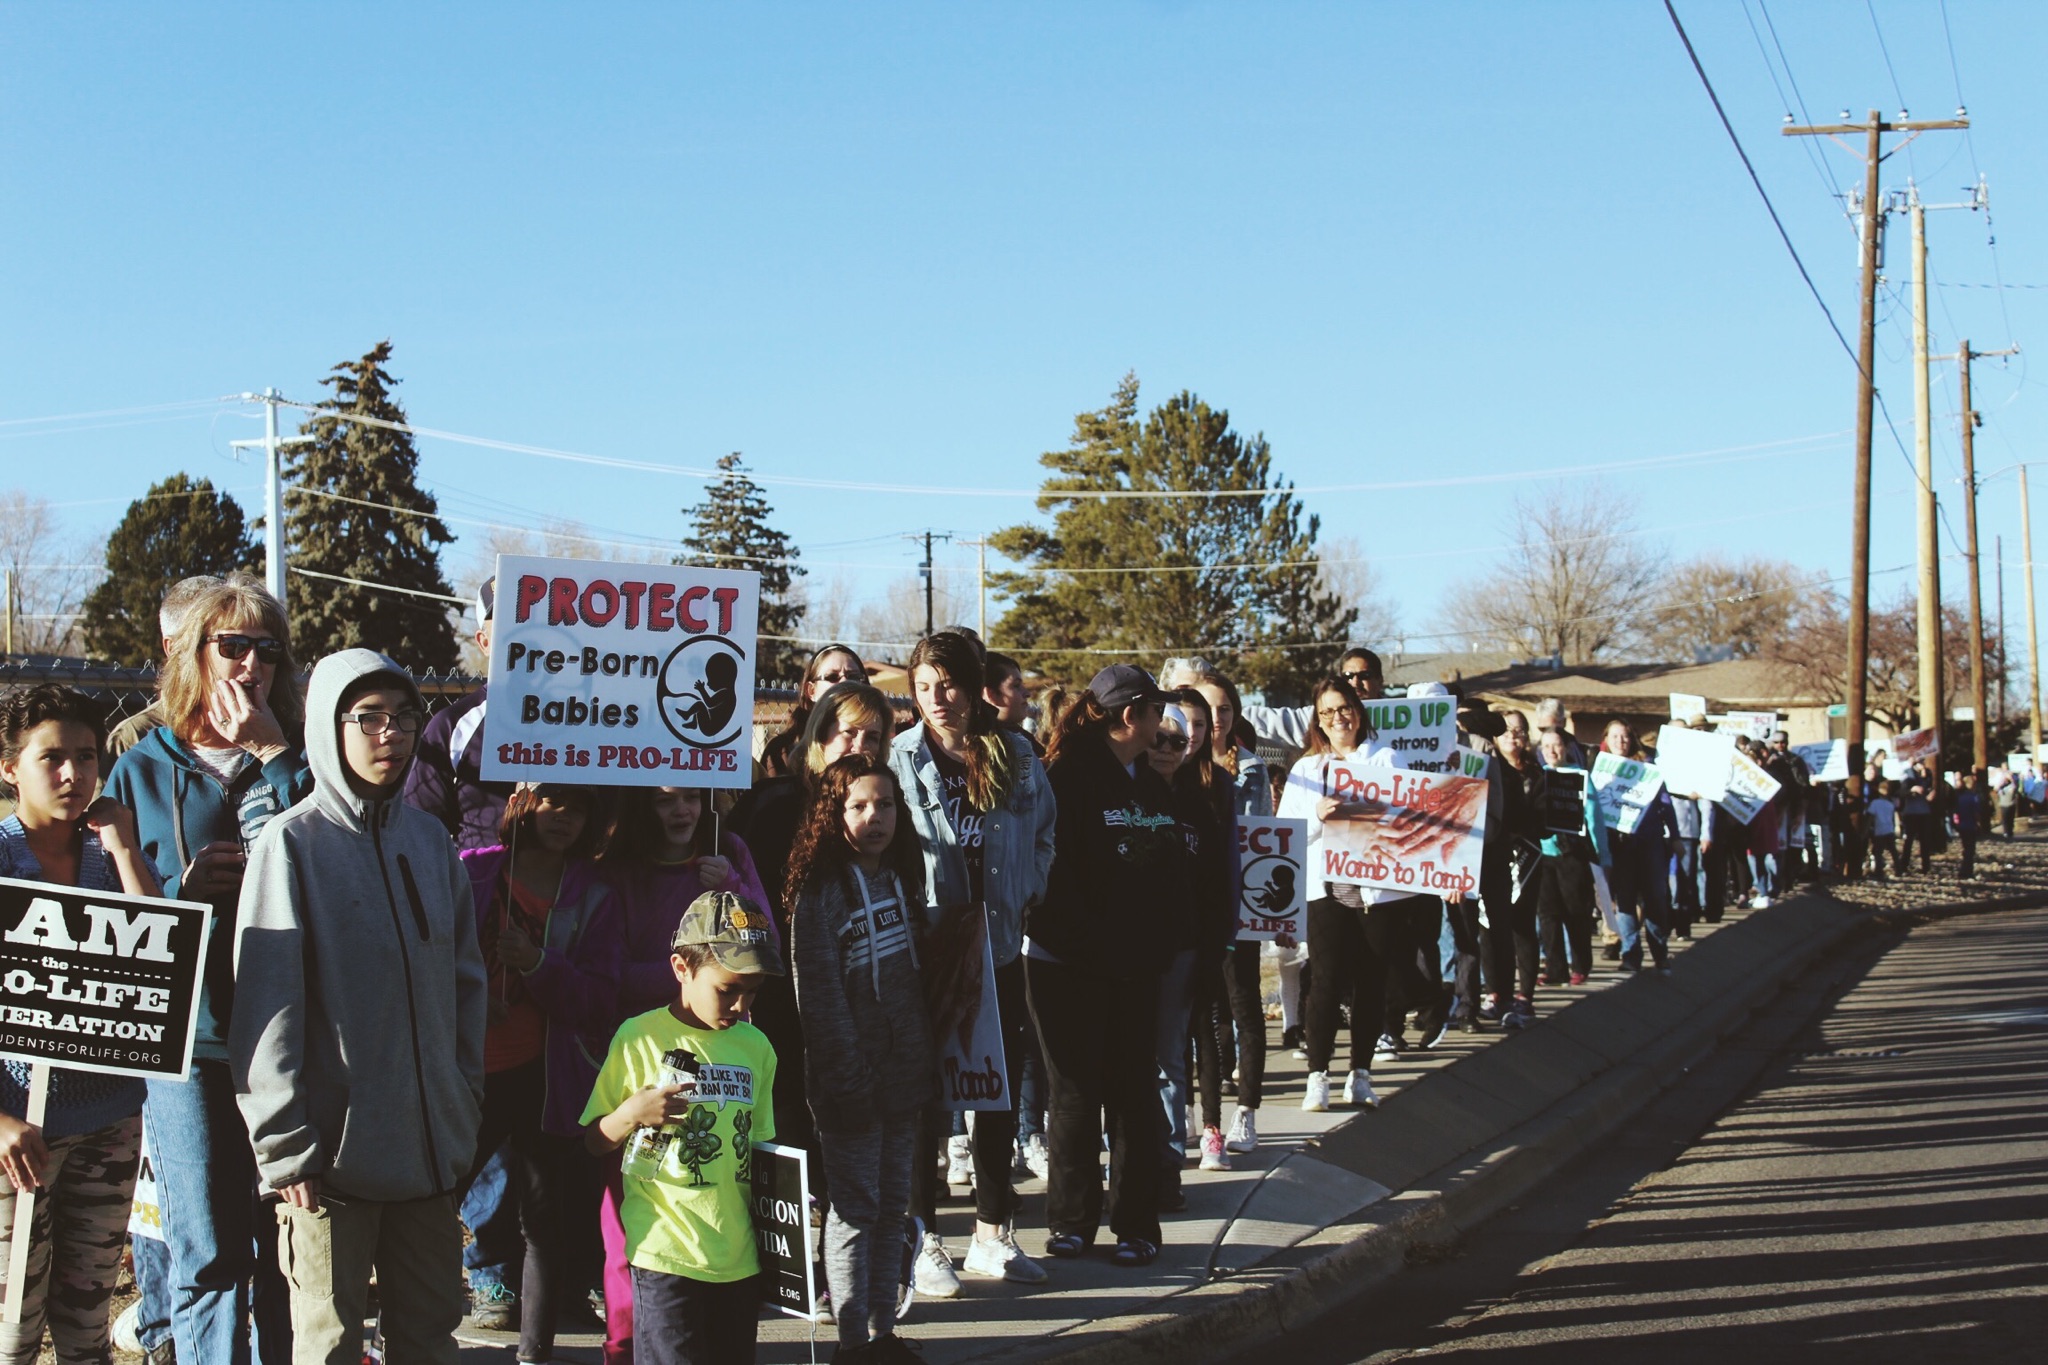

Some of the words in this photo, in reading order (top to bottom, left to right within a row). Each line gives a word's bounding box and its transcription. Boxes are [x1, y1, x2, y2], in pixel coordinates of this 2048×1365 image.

[515, 574, 739, 636] PROTECT
[507, 642, 659, 677] Pre-Born
[521, 694, 639, 728] Babies
[1420, 702, 1450, 727] UP
[497, 742, 558, 766] this
[564, 744, 591, 767] is
[597, 745, 738, 772] PRO-LIFE
[1391, 736, 1439, 751] strong
[1464, 753, 1485, 777] UP
[1334, 768, 1442, 813] Pro-Life
[1325, 849, 1389, 881] Womb
[1393, 861, 1415, 885] to
[1420, 861, 1475, 892] Tomb
[4, 897, 179, 963] AM
[878, 909, 900, 926] LOVE
[41, 956, 69, 970] the
[0, 969, 171, 1014] O-LIFE
[701, 1083, 721, 1096] RAN
[710, 1069, 732, 1082] LIKE
[944, 1055, 1003, 1101] Tomb
